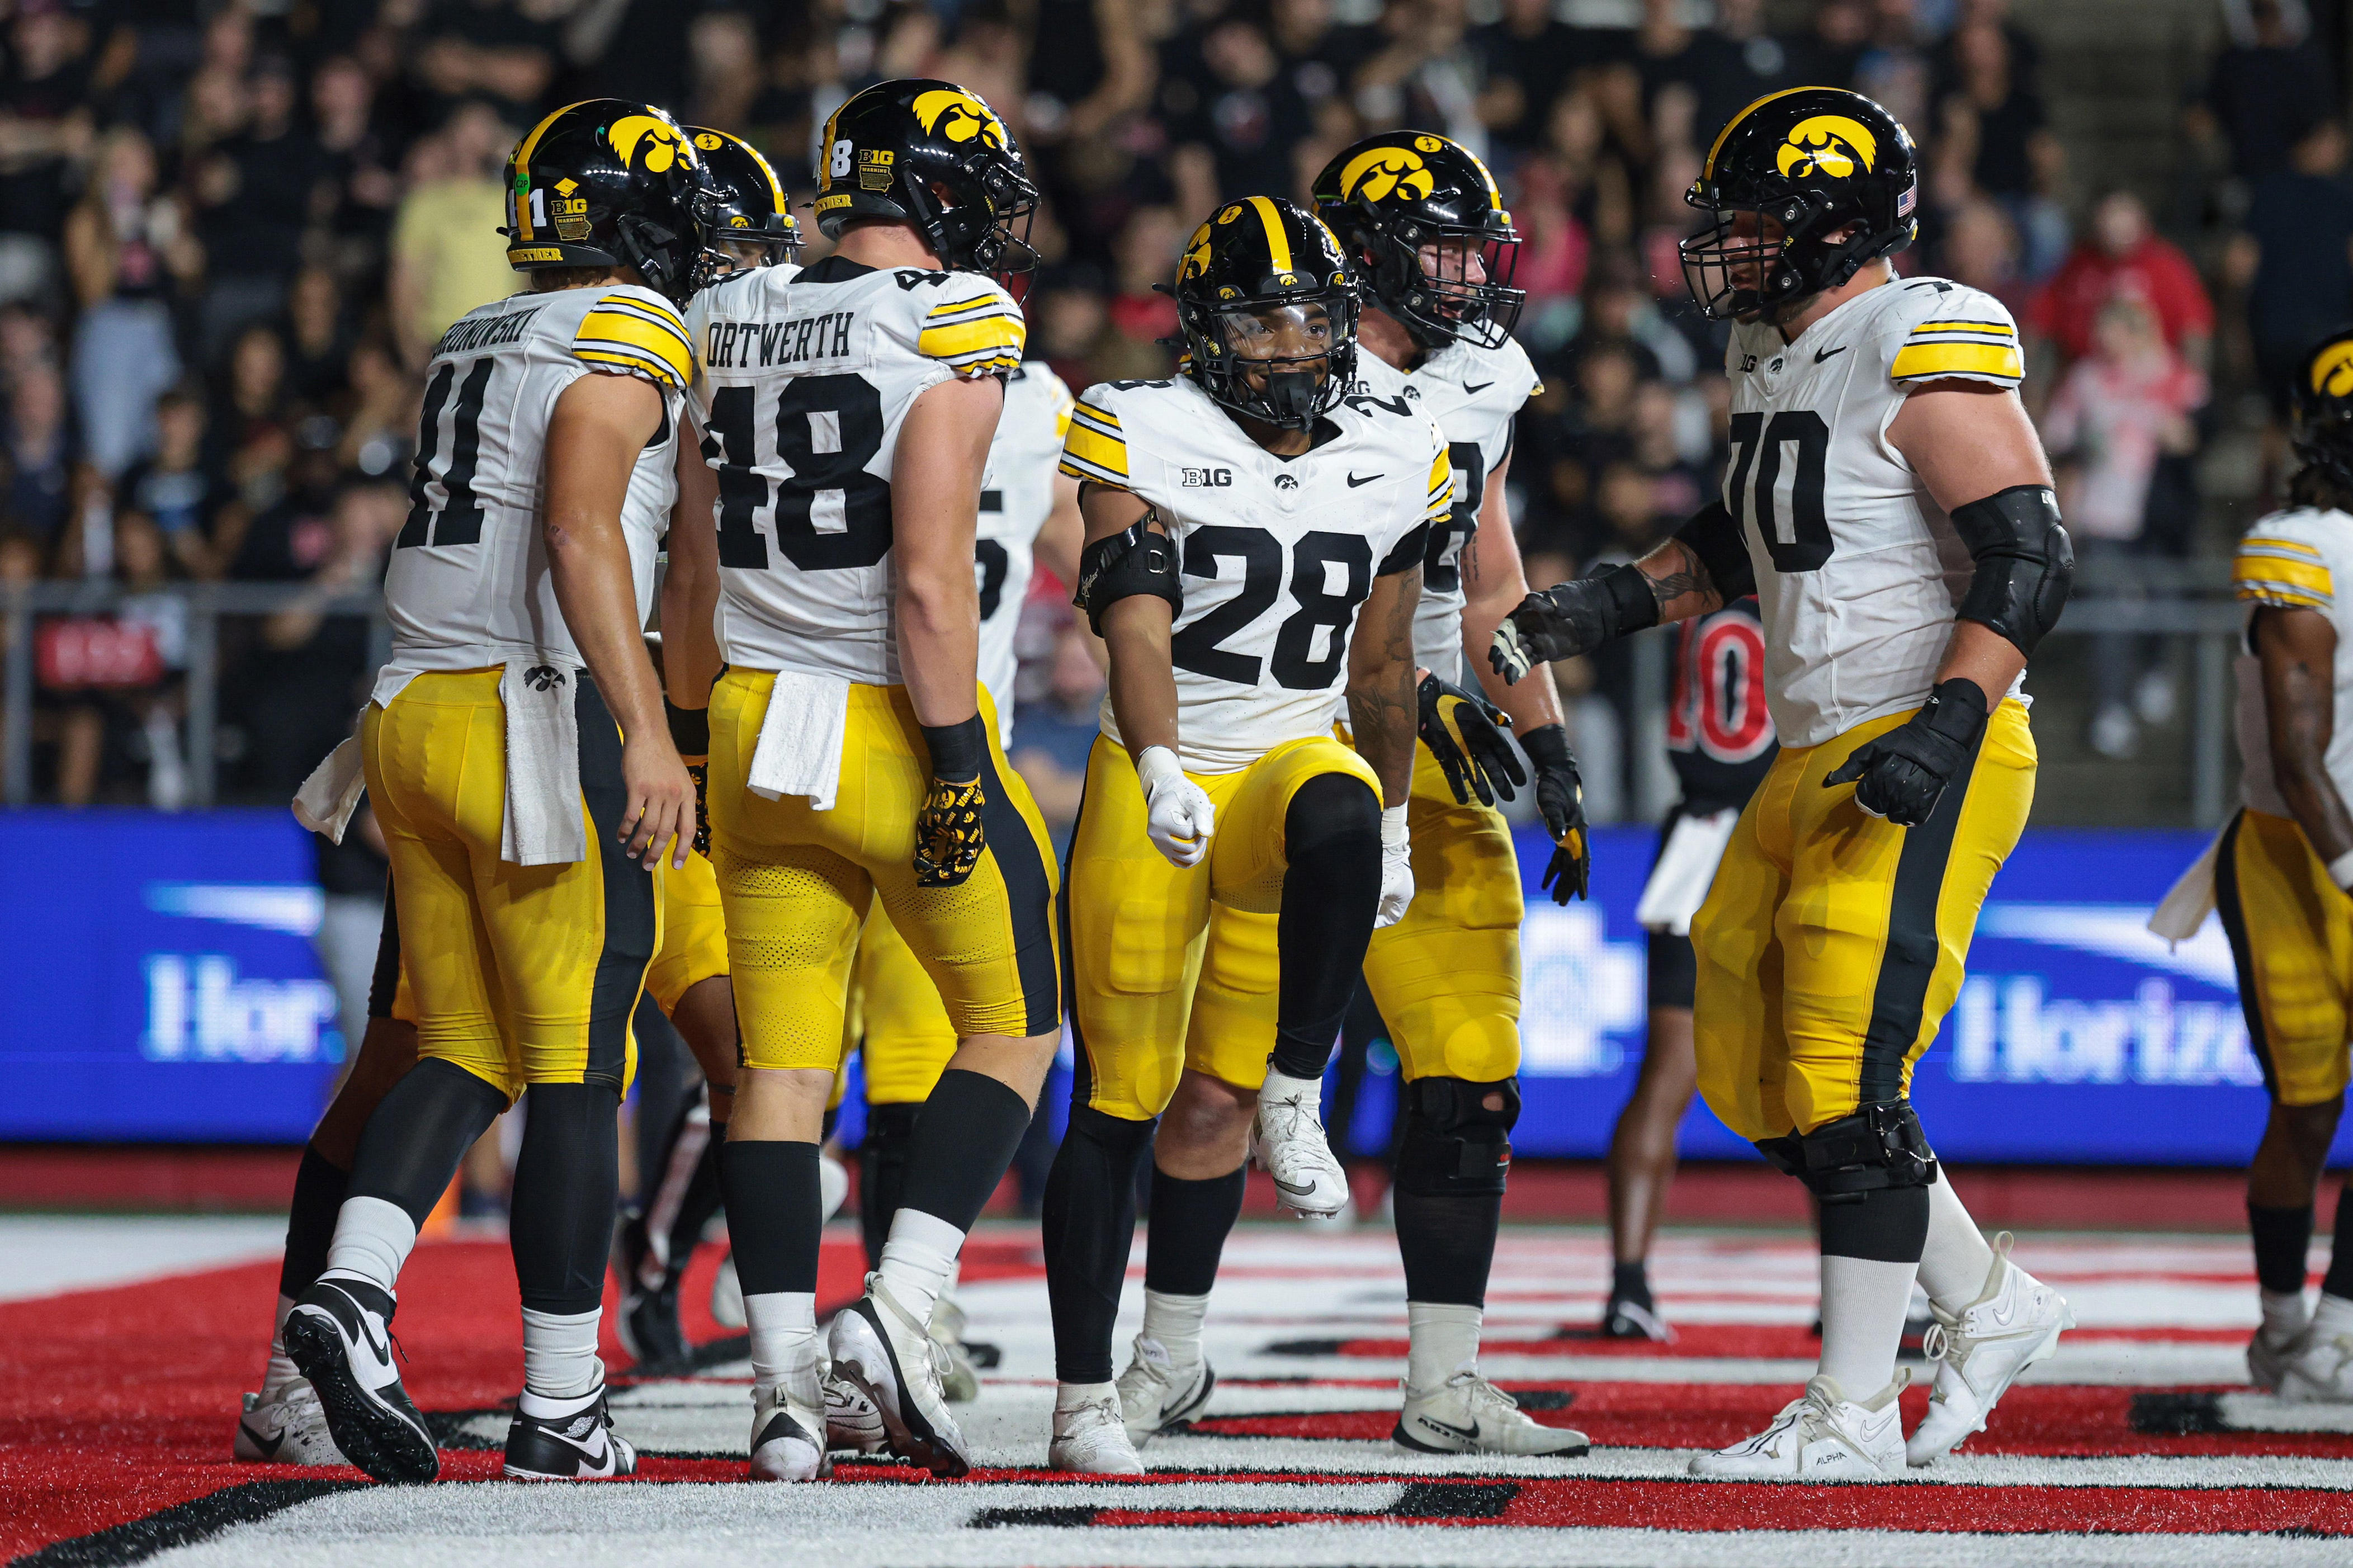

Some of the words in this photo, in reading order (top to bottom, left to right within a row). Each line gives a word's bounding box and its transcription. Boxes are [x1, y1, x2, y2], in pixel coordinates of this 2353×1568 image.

[707, 312, 854, 368] ORTWERTH
[396, 357, 494, 549] 11
[700, 373, 894, 571] 48
[1730, 410, 1835, 573] 70
[1171, 526, 1373, 690] 28
[1666, 611, 1777, 764] 10
[946, 811, 956, 825] IOWA
[956, 786, 975, 807] IOWA
[968, 828, 980, 843] IOWA
[145, 952, 344, 1064] Hor
[1816, 1452, 1847, 1466] ALPHA
